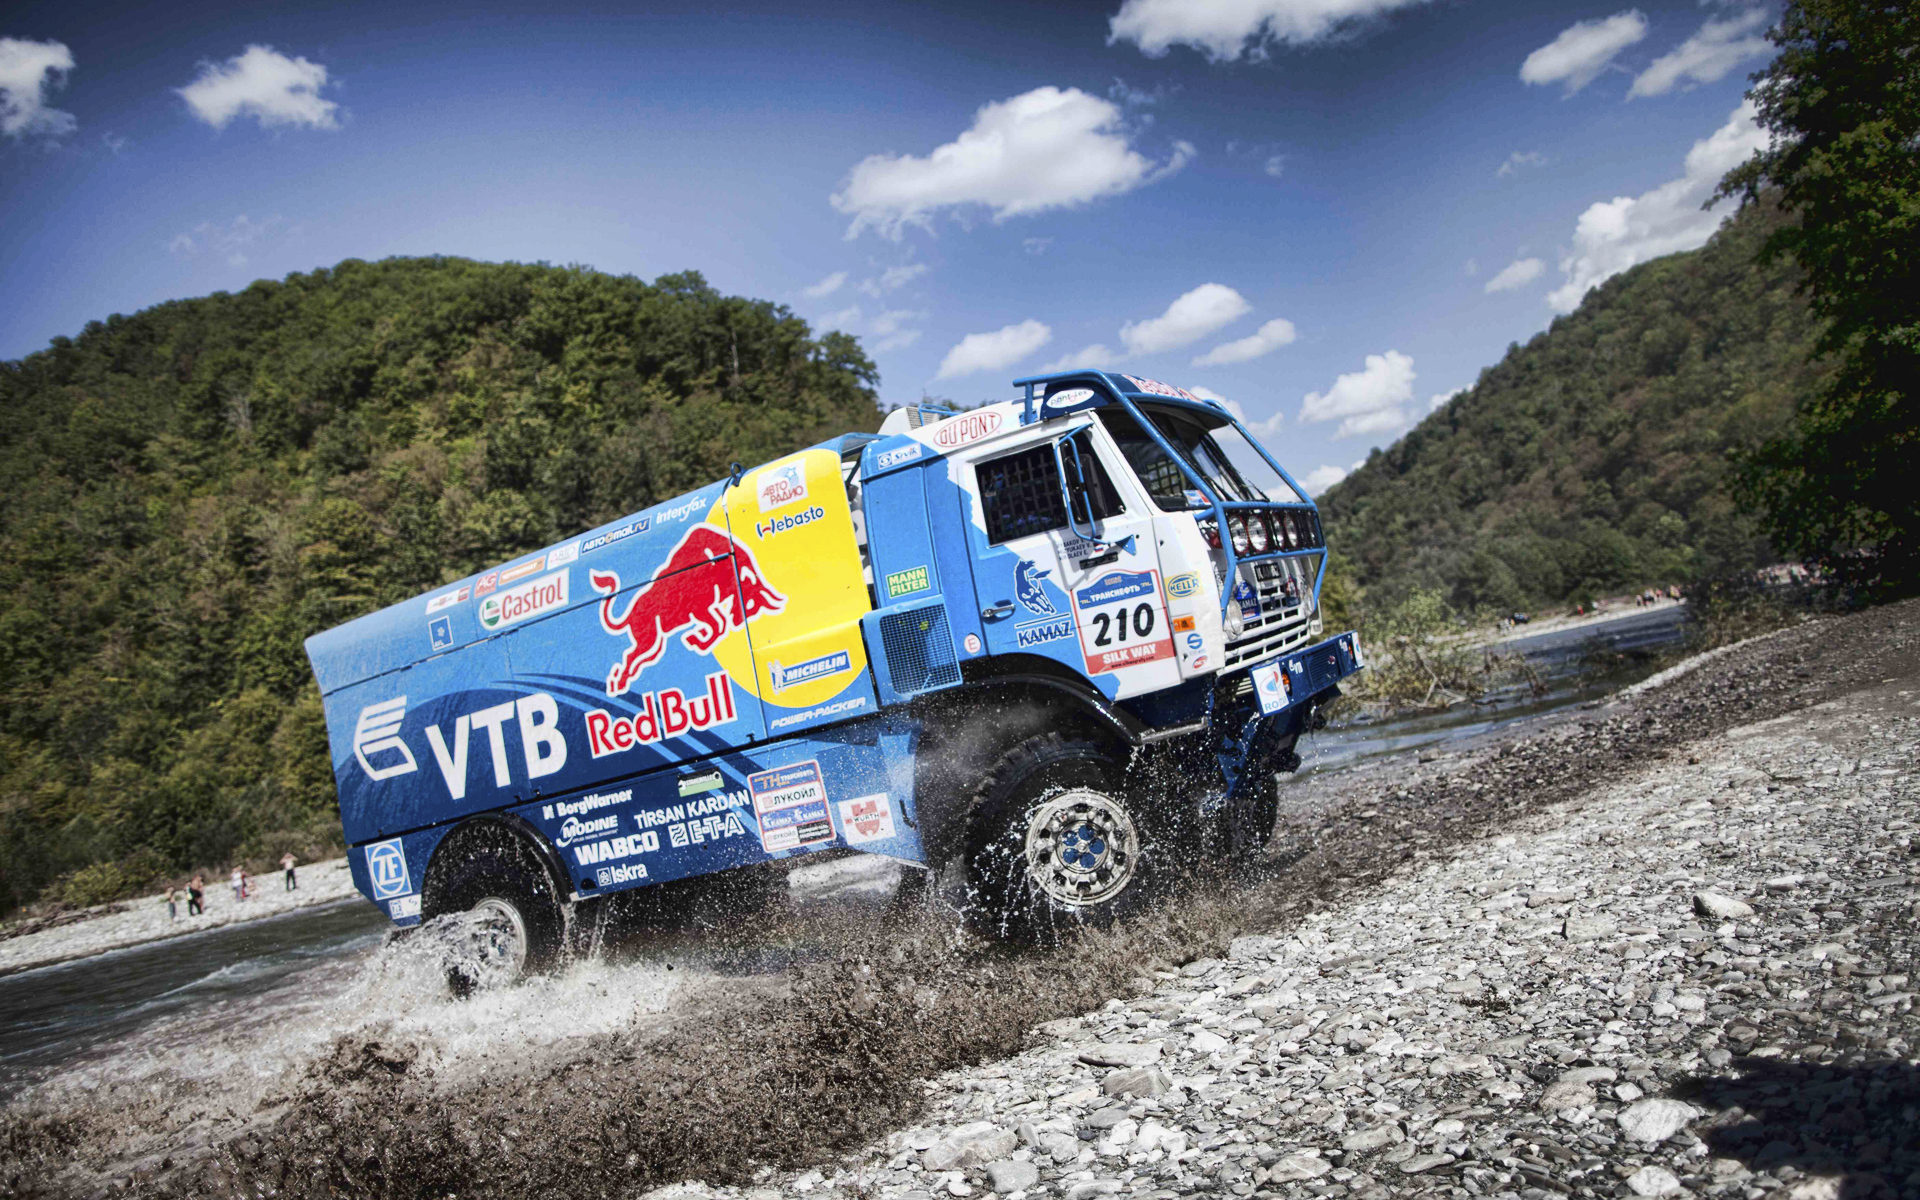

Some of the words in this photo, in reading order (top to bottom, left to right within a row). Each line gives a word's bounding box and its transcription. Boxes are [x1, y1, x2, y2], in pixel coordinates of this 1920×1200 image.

[960, 414, 996, 443] PONT
[762, 480, 788, 498] АВТО
[770, 485, 804, 505] РАДИО
[656, 496, 707, 524] interfax
[757, 506, 825, 539] Webasto
[889, 568, 926, 586] MANN
[890, 578, 928, 596] FILTER
[502, 576, 563, 620] Castrol
[1090, 584, 1141, 602] ТРАНСНЕФТЬ
[1018, 620, 1074, 647] KAMAZ
[1092, 602, 1155, 647] 210
[968, 637, 978, 651] E
[1102, 647, 1128, 664] SILK
[1130, 643, 1157, 659] WAY
[786, 654, 847, 681] MICHELIN
[586, 691, 660, 758] Red
[661, 670, 737, 740] Bull
[771, 697, 866, 729] POWER-PACKER
[424, 692, 568, 801] VTB
[556, 789, 633, 816] BorgWarner
[686, 789, 750, 818] KARDAN
[773, 786, 816, 806] ЛУКОЙЛ
[563, 815, 618, 839] MODINE
[687, 812, 746, 844] E-T-A
[574, 831, 660, 866] WABCO
[371, 851, 405, 886] ZF
[610, 863, 649, 884] Iskra
